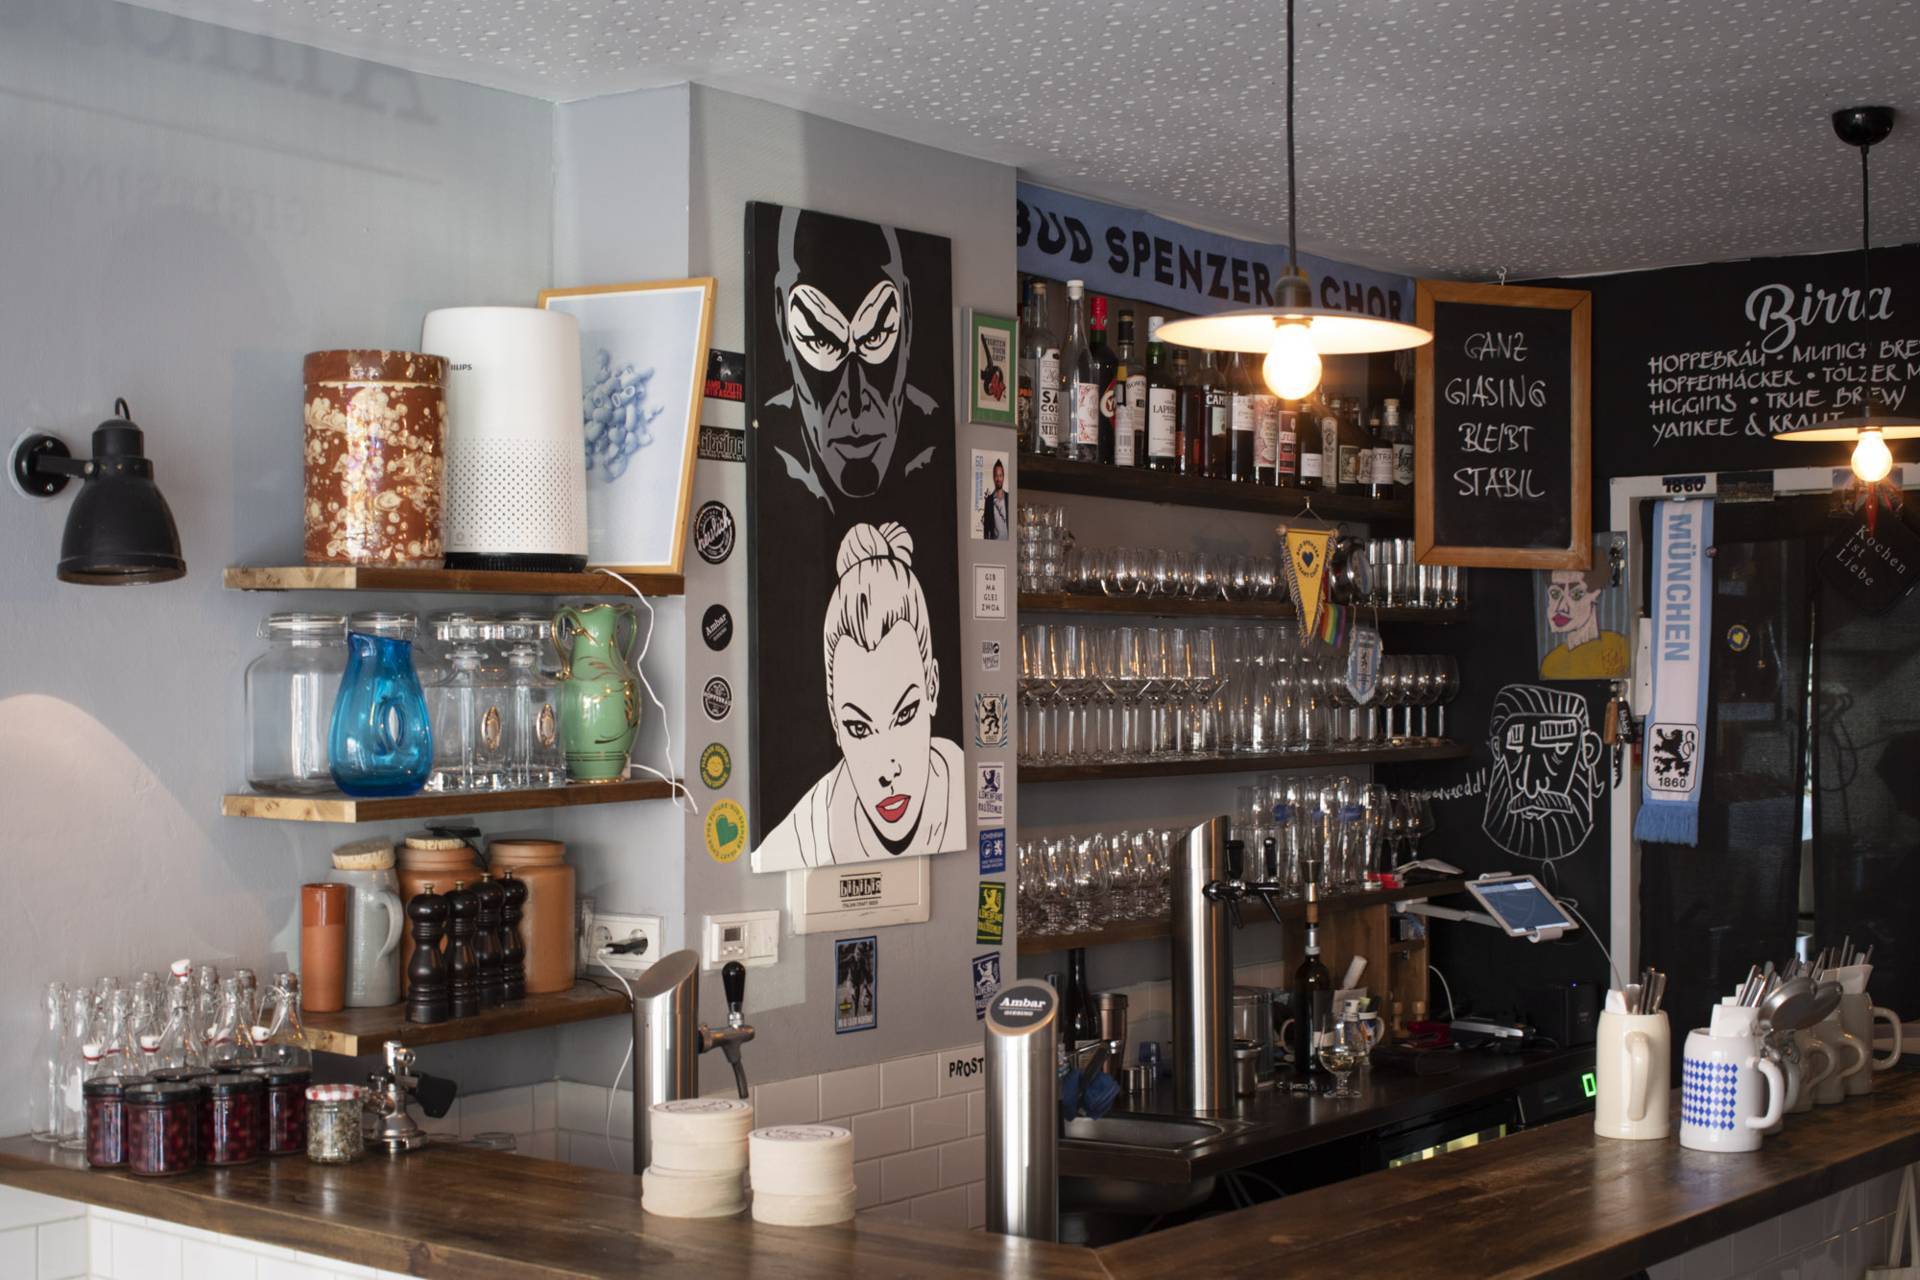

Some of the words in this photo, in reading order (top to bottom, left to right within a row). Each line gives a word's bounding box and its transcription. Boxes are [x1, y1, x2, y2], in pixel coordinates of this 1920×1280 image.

[1105, 226, 1275, 307] SPENZER
[1320, 276, 1401, 321] CHOR
[1745, 283, 1895, 354] Birra
[1464, 331, 1528, 362] GANZ
[1444, 375, 1548, 408] GIASING
[1649, 393, 1737, 416] HIGGINS
[1765, 389, 1826, 409] TRUE
[1458, 422, 1537, 453] BLEIBT
[1652, 417, 1739, 448] YANKEE
[1744, 412, 1767, 438] &
[1453, 467, 1546, 498] STABIL
[1664, 513, 1696, 662] MÜNCHEN
[1658, 776, 1687, 789] 1860
[999, 997, 1047, 1008] Ambar
[949, 1057, 985, 1078] PROST
